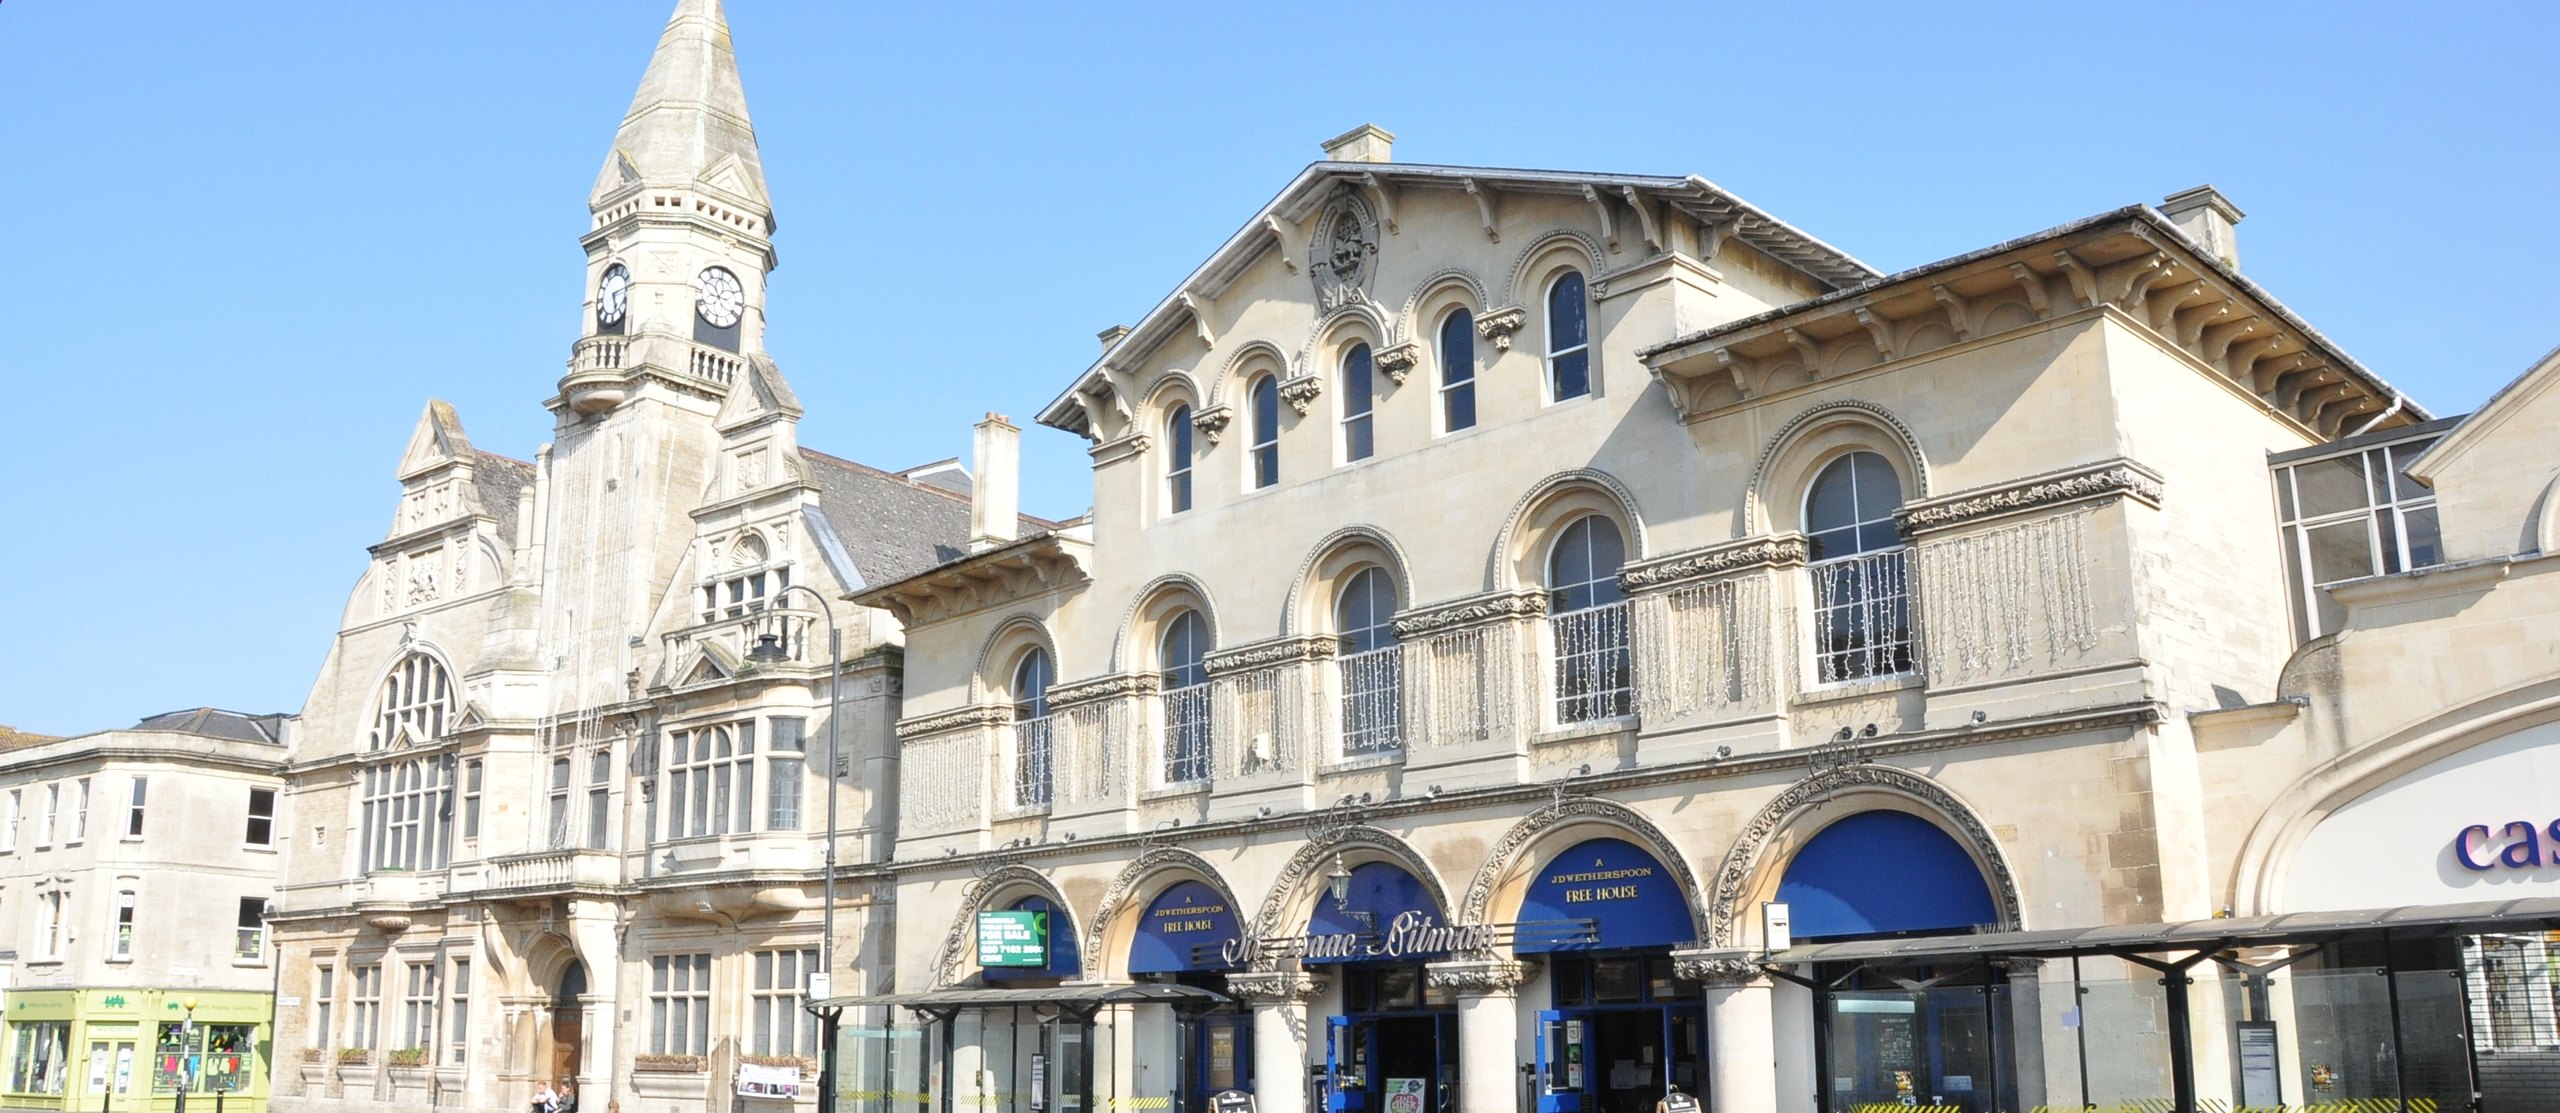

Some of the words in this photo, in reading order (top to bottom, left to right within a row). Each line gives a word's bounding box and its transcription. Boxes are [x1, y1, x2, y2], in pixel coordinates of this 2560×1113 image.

[1595, 858, 1604, 867] A
[1566, 888, 1593, 903] FREE
[1596, 885, 1638, 901] HOUSE
[1164, 921, 1183, 933] FREE
[1185, 919, 1213, 932] HOUSE
[980, 930, 1003, 940] FOR
[1003, 930, 1031, 940] SALE
[1276, 919, 1357, 959] Isaac
[1367, 910, 1499, 957] Pitman
[1392, 1101, 1417, 1110] CIDER
